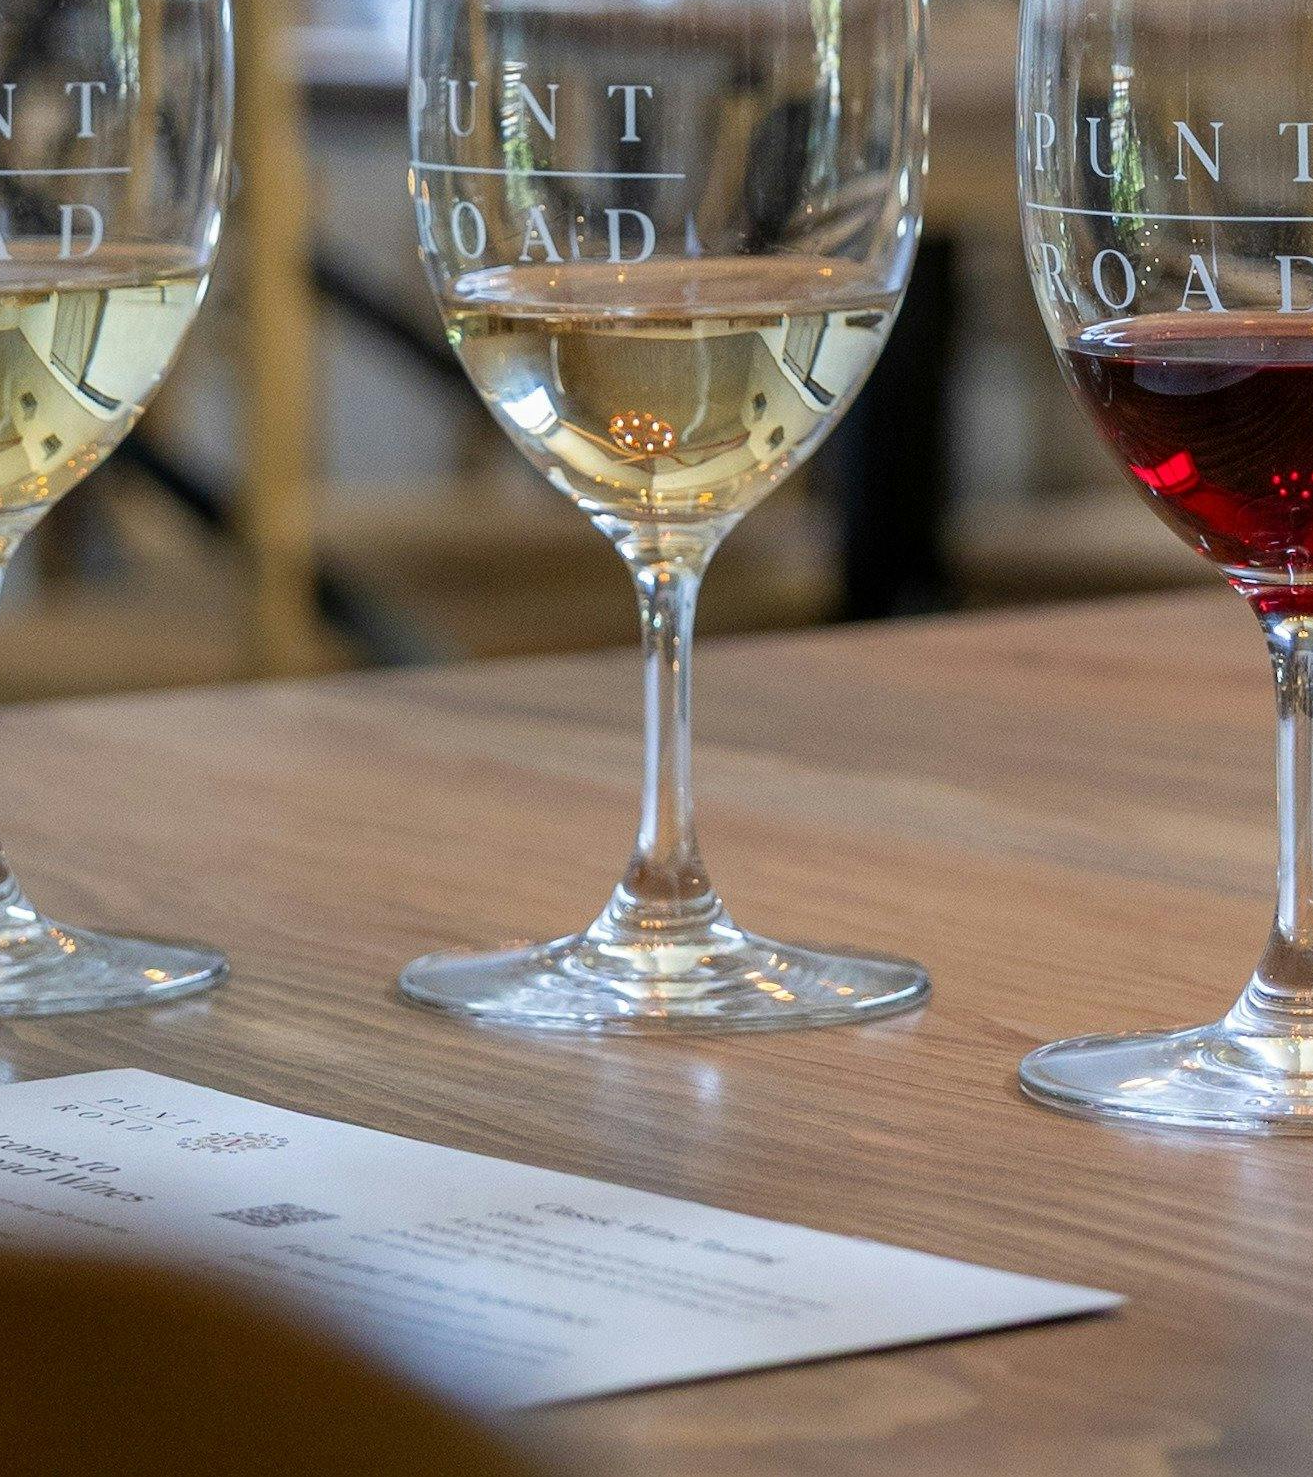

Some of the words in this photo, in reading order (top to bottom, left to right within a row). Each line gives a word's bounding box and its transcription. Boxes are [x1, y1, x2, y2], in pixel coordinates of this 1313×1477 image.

[53, 1104, 153, 1132] ROAD
[97, 1097, 201, 1126] PUNT
[76, 1161, 120, 1174] to
[45, 1173, 154, 1203] Wines
